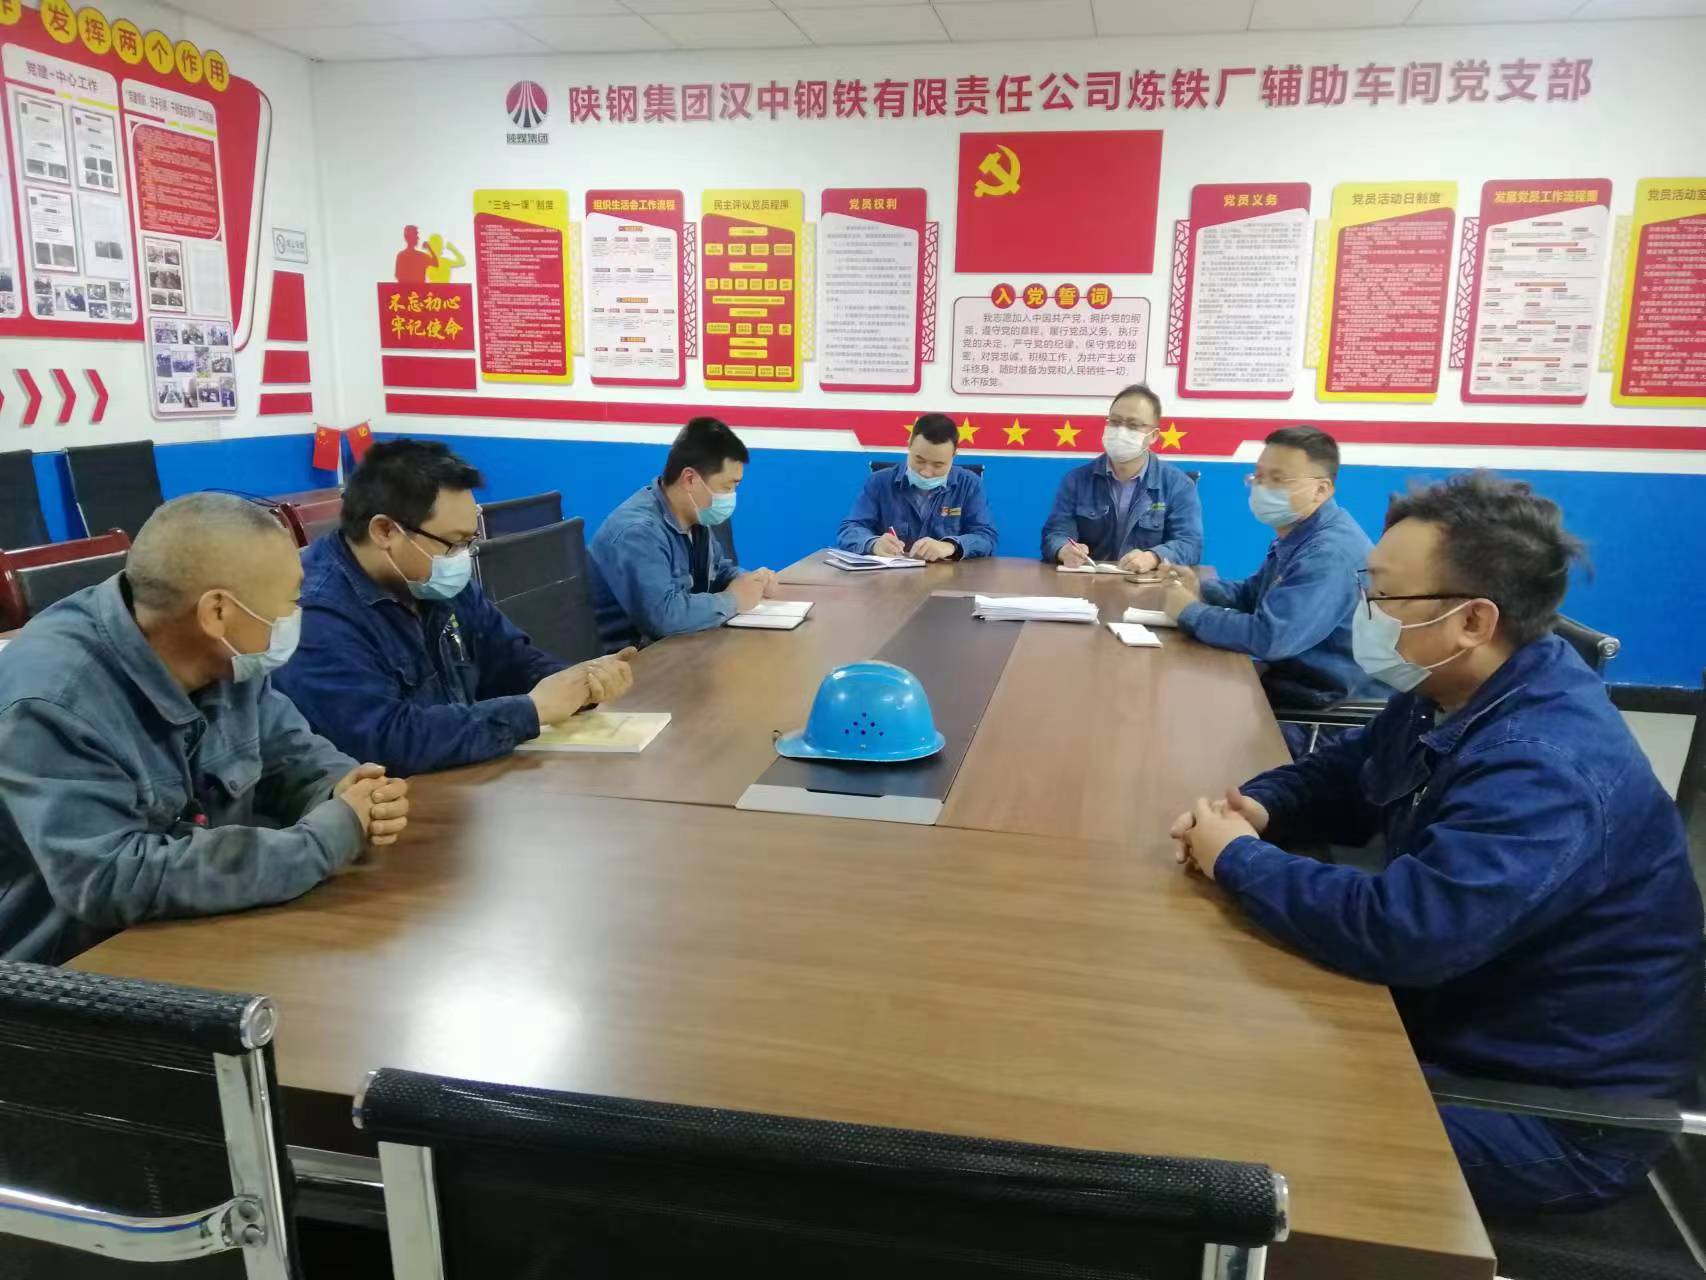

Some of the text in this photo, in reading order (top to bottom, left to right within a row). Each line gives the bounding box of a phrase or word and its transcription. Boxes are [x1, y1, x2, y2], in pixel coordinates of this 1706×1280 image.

[568, 58, 1594, 123] 陕钢集团汉中钢铁有限责任公司炼铁厂辅助车间党支部
[593, 199, 675, 211] 组织生活会工作流程
[849, 198, 897, 210] 党员权利
[1223, 193, 1278, 207] 党员义务
[1352, 192, 1440, 205] 党员活动日制度
[389, 292, 460, 312] 不忘初心
[996, 287, 1108, 305] 入党誓词
[391, 317, 463, 339] 牢记使命
